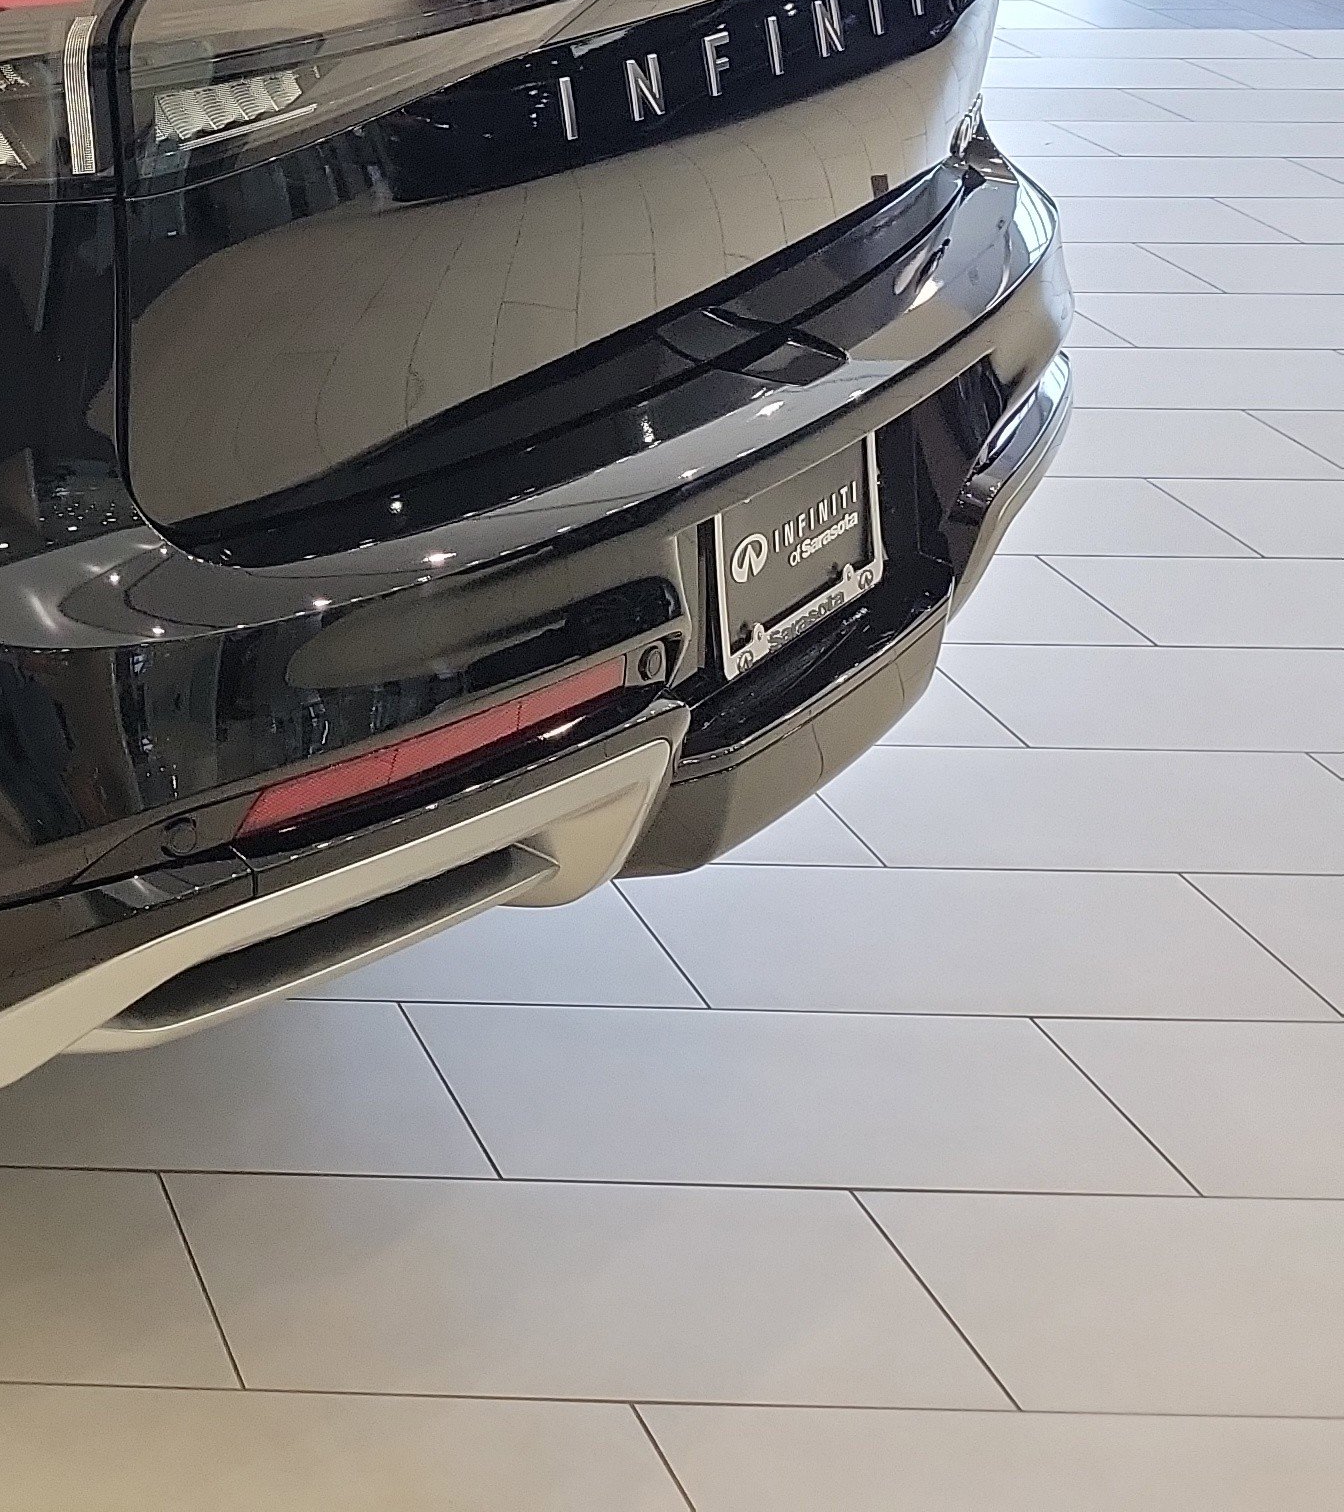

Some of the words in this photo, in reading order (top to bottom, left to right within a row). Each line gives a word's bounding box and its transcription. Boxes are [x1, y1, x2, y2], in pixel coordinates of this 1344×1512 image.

[773, 480, 858, 553] INFINITI
[788, 545, 802, 568] of
[802, 511, 859, 559] Sarasota
[767, 591, 846, 651] Sarasota
